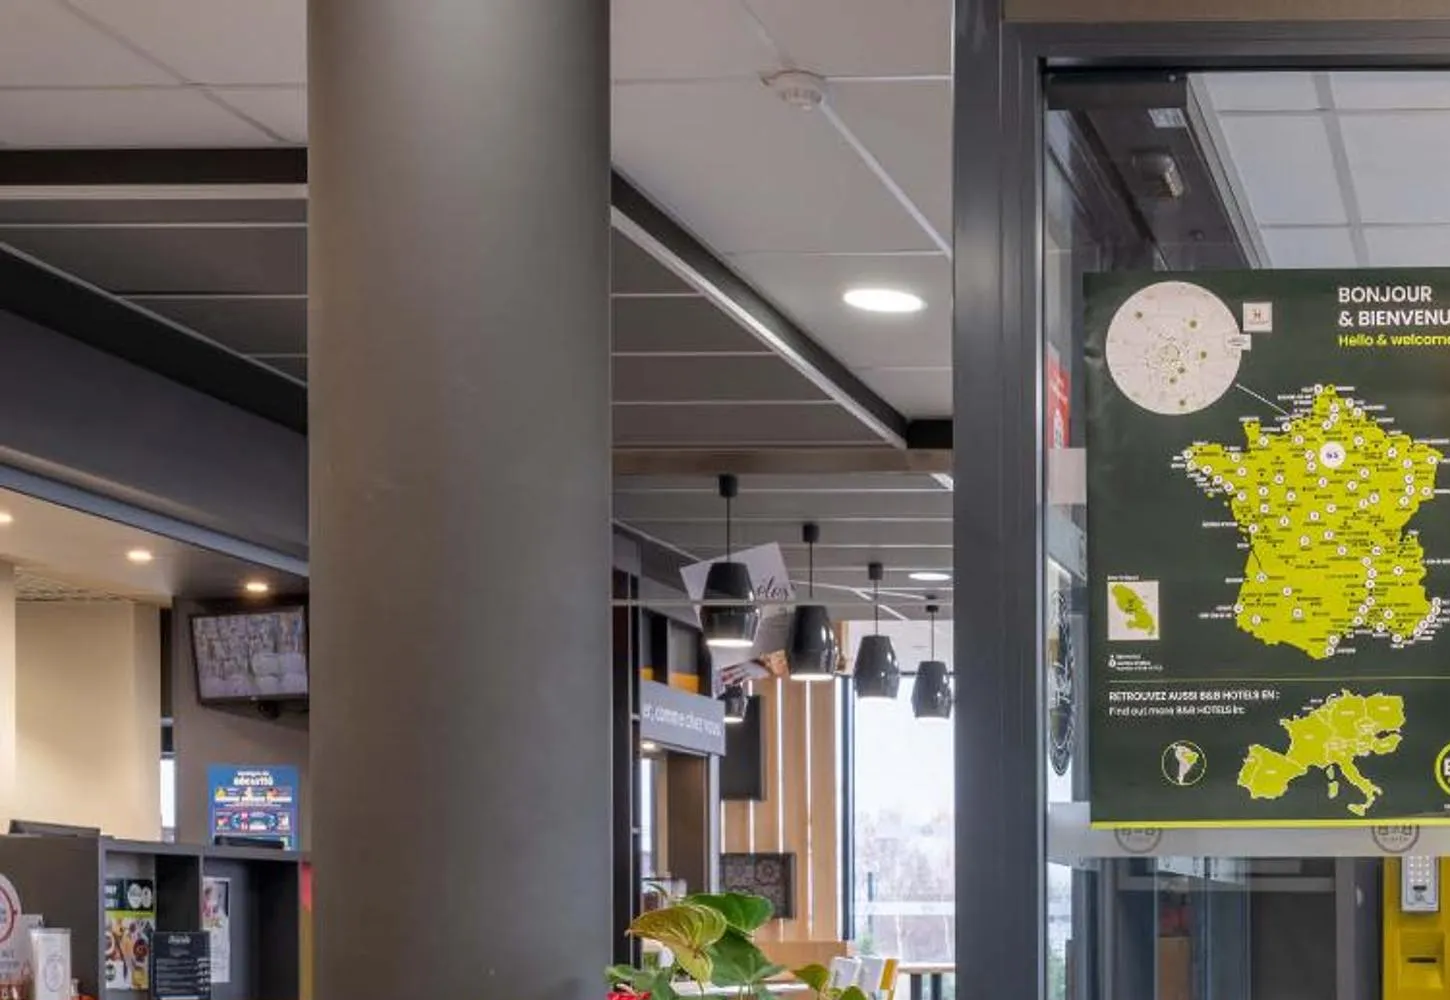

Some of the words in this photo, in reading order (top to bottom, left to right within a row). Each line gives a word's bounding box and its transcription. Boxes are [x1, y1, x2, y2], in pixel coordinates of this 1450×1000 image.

[1338, 285, 1432, 303] BONJOUR
[1338, 310, 1354, 328] &
[1338, 333, 1374, 348] Hello
[1377, 333, 1388, 347] &
[1109, 691, 1167, 701] RETROUVEZ
[1168, 691, 1198, 701] AUSSI
[1199, 690, 1221, 701] B&B
[1222, 690, 1260, 700] HOTELS
[1261, 689, 1275, 700] EN
[1109, 706, 1130, 716] Find
